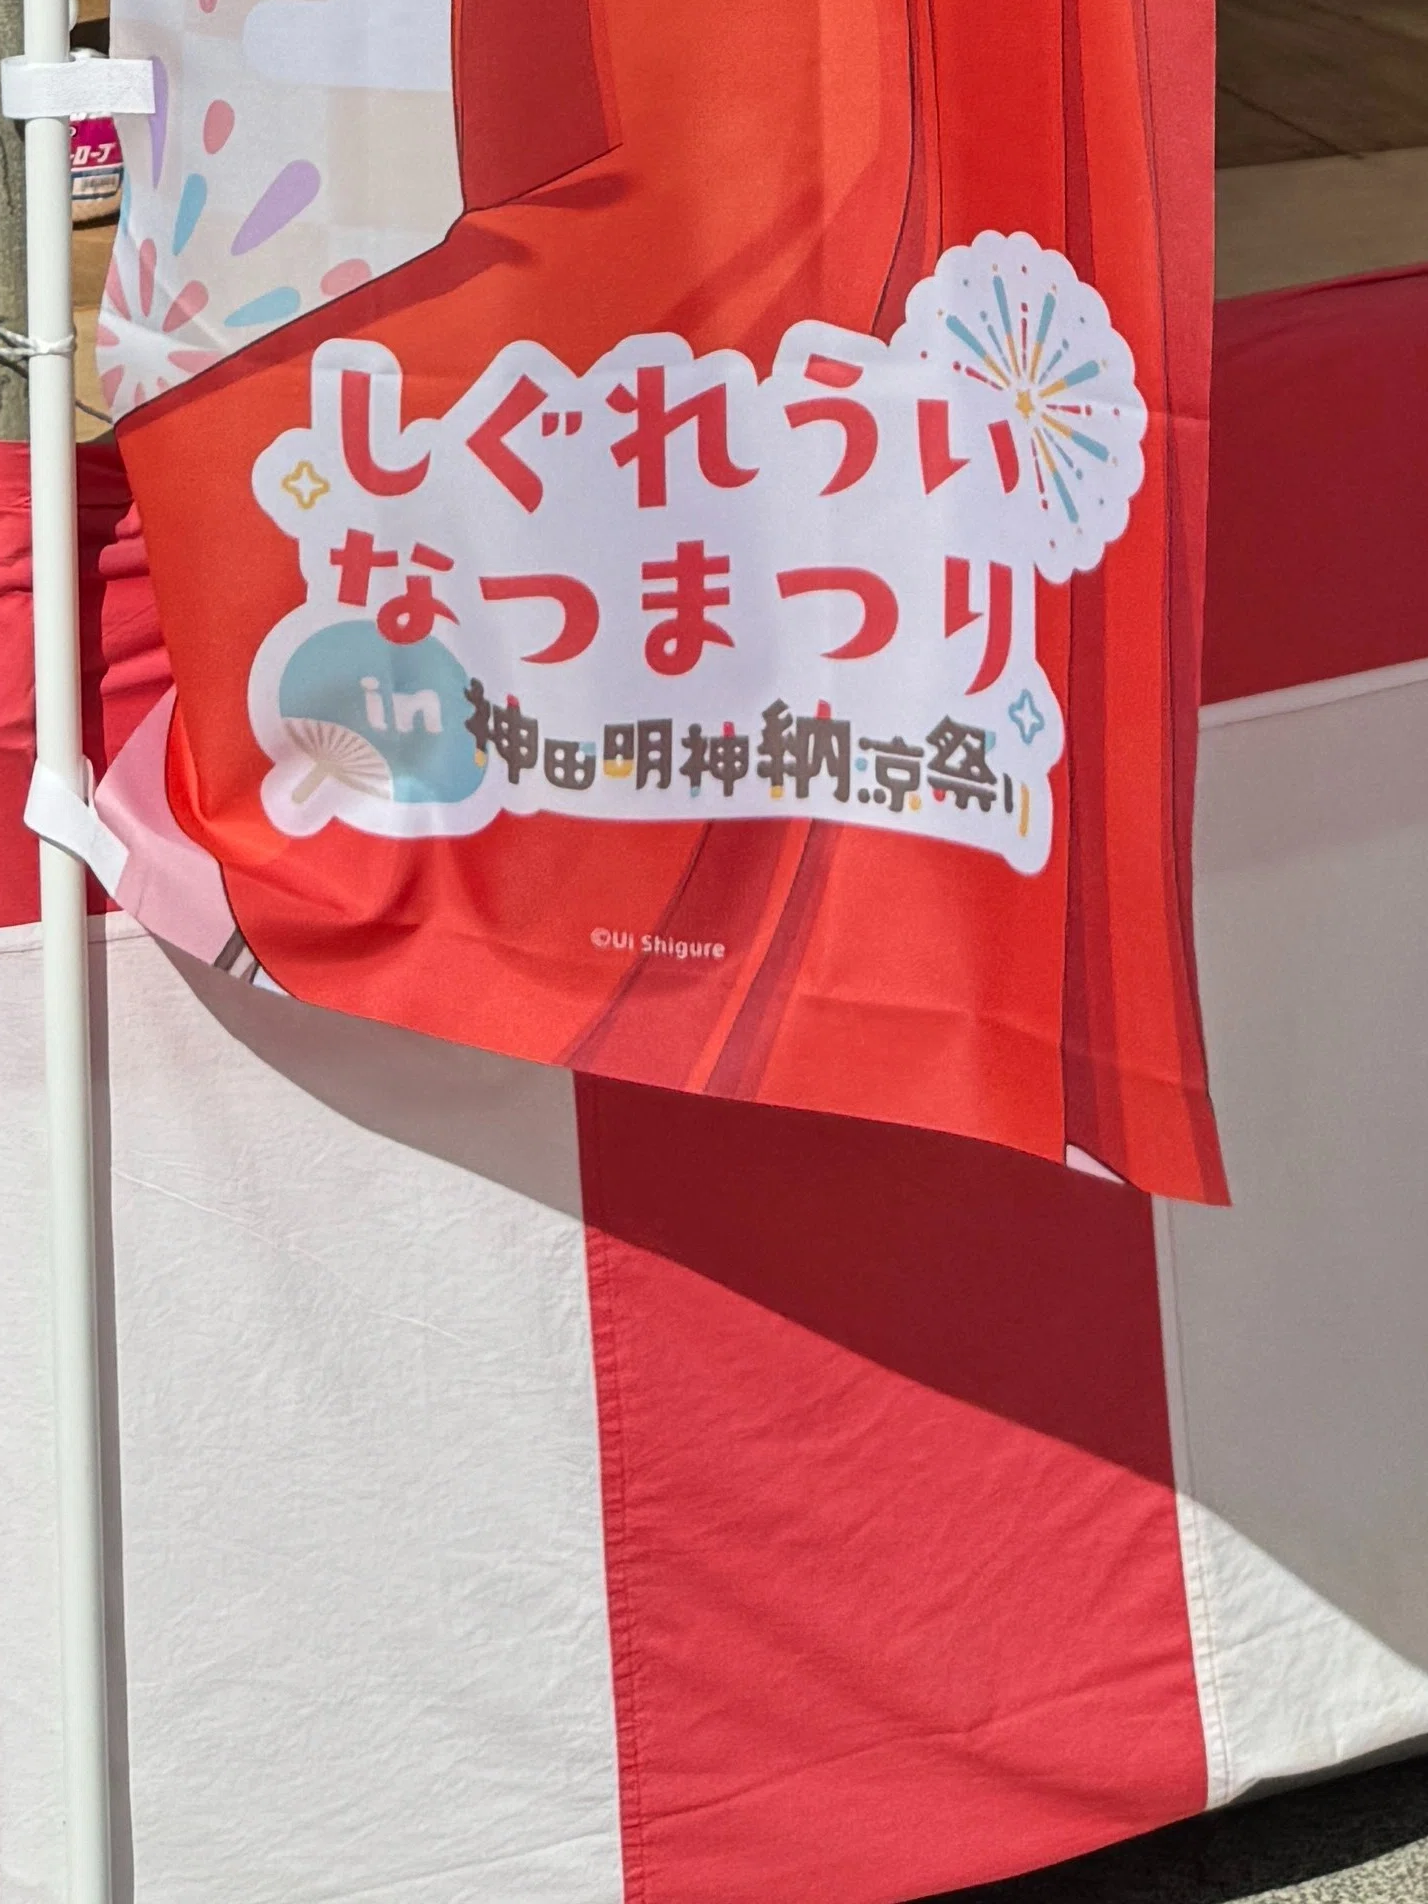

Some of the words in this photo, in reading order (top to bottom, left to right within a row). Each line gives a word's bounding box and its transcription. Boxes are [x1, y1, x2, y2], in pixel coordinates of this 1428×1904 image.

[340, 354, 1019, 514] しぐれうい
[329, 528, 1013, 697] なつまつり
[360, 676, 442, 733] in
[464, 676, 999, 813] 神田明神納涼祭
[641, 934, 726, 959] Shigure
